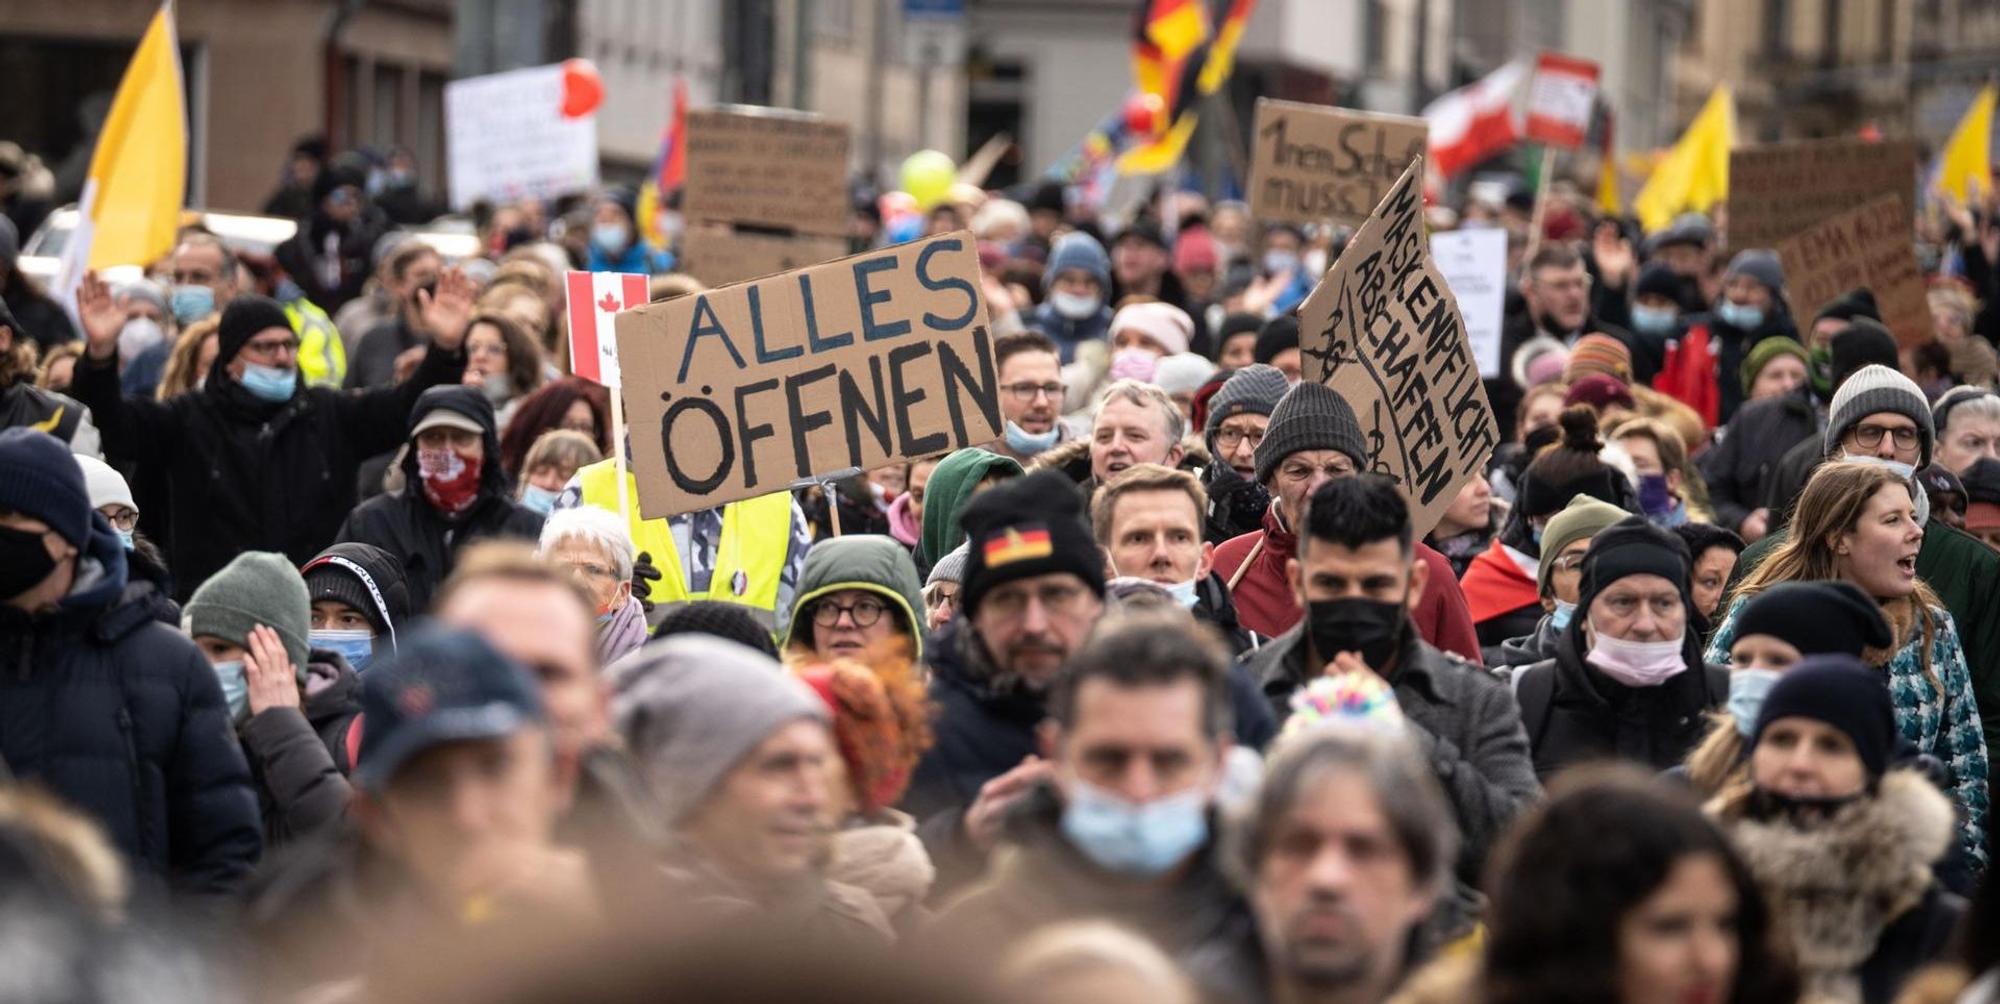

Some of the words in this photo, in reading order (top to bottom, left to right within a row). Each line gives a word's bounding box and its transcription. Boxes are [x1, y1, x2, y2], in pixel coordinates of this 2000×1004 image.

[660, 325, 1003, 495] ÖFFNEN
[677, 239, 979, 384] ALLES
[1355, 250, 1453, 506] ABSCHAFFEN
[1380, 174, 1494, 476] MASKENPFLICHT
